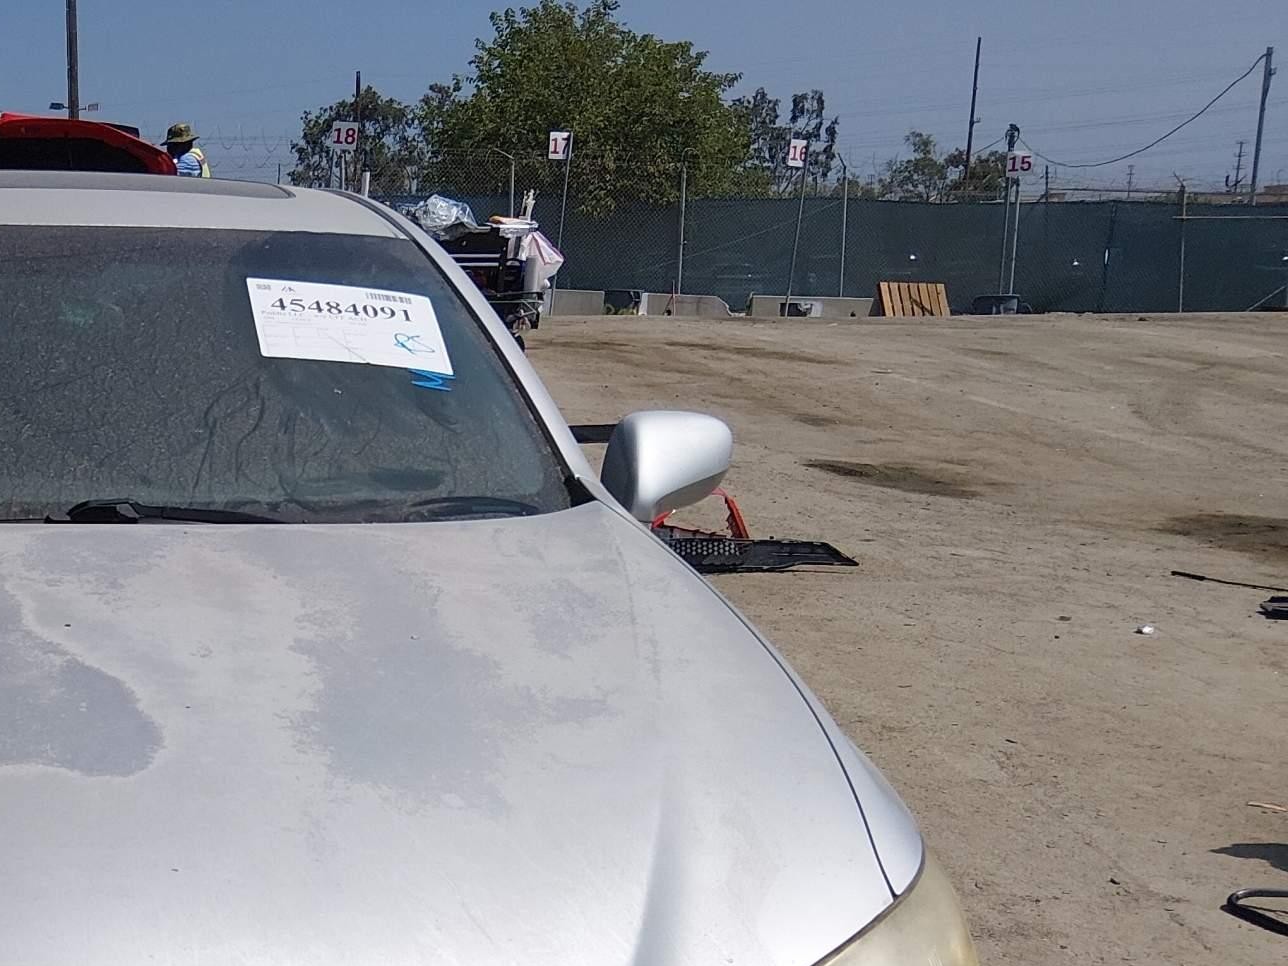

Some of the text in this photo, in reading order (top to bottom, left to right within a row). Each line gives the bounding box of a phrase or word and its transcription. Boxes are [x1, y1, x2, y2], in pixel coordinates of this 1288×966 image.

[333, 127, 357, 145] 18
[550, 137, 570, 155] 17
[1007, 155, 1032, 172] 15
[270, 297, 413, 322] 45484091
